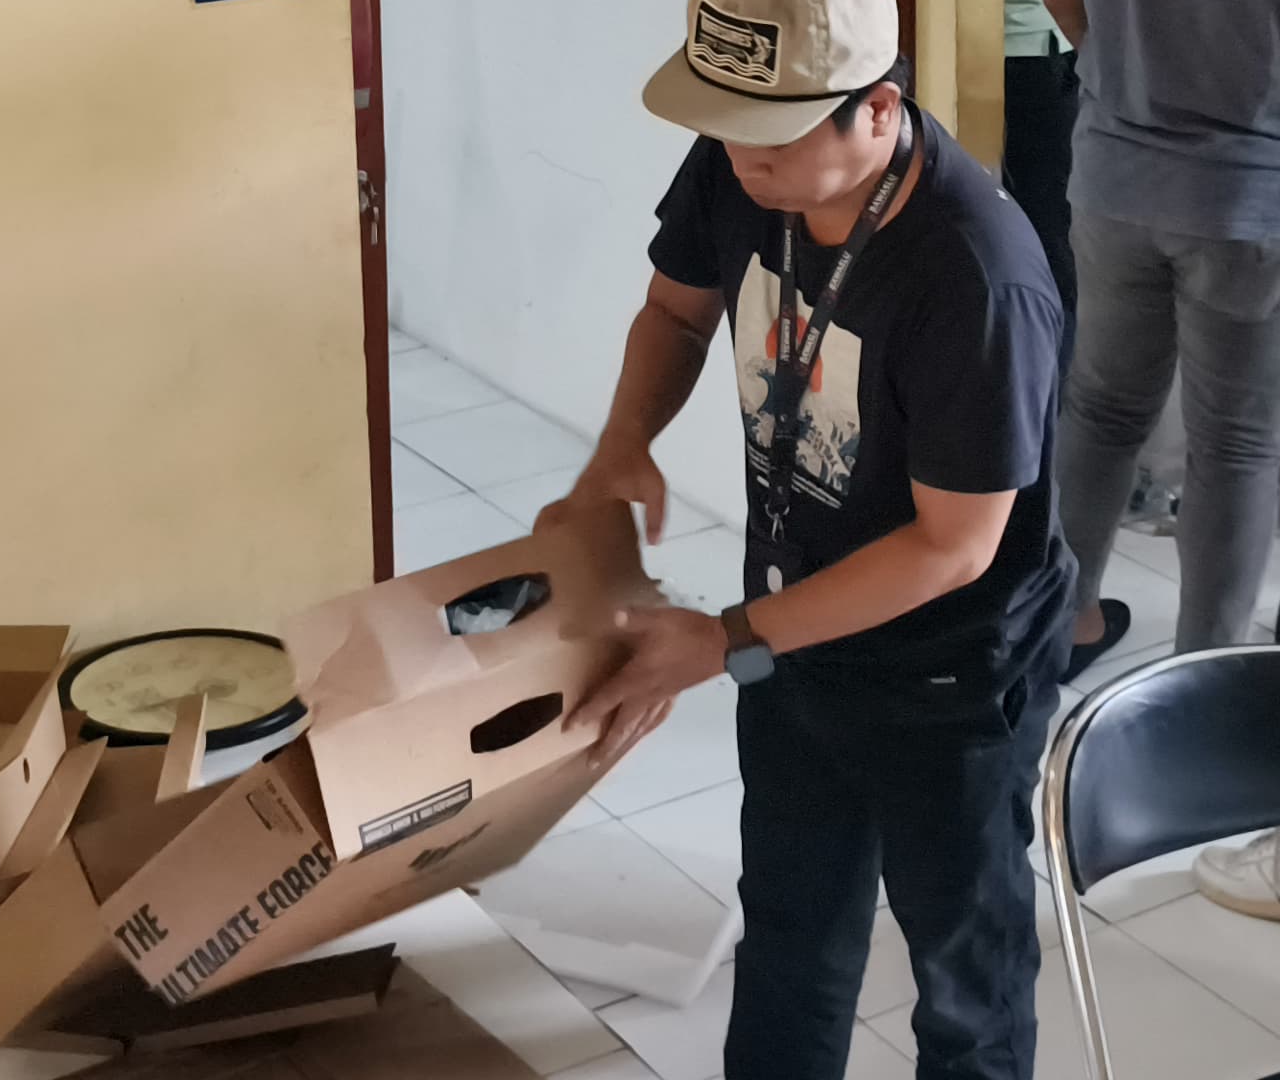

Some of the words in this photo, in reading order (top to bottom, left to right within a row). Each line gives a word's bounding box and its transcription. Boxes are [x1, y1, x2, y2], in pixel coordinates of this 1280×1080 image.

[867, 173, 900, 215] BAWASLU
[257, 840, 333, 919] FORCE
[113, 903, 169, 960] THE
[157, 905, 260, 1005] ULTIMATE
